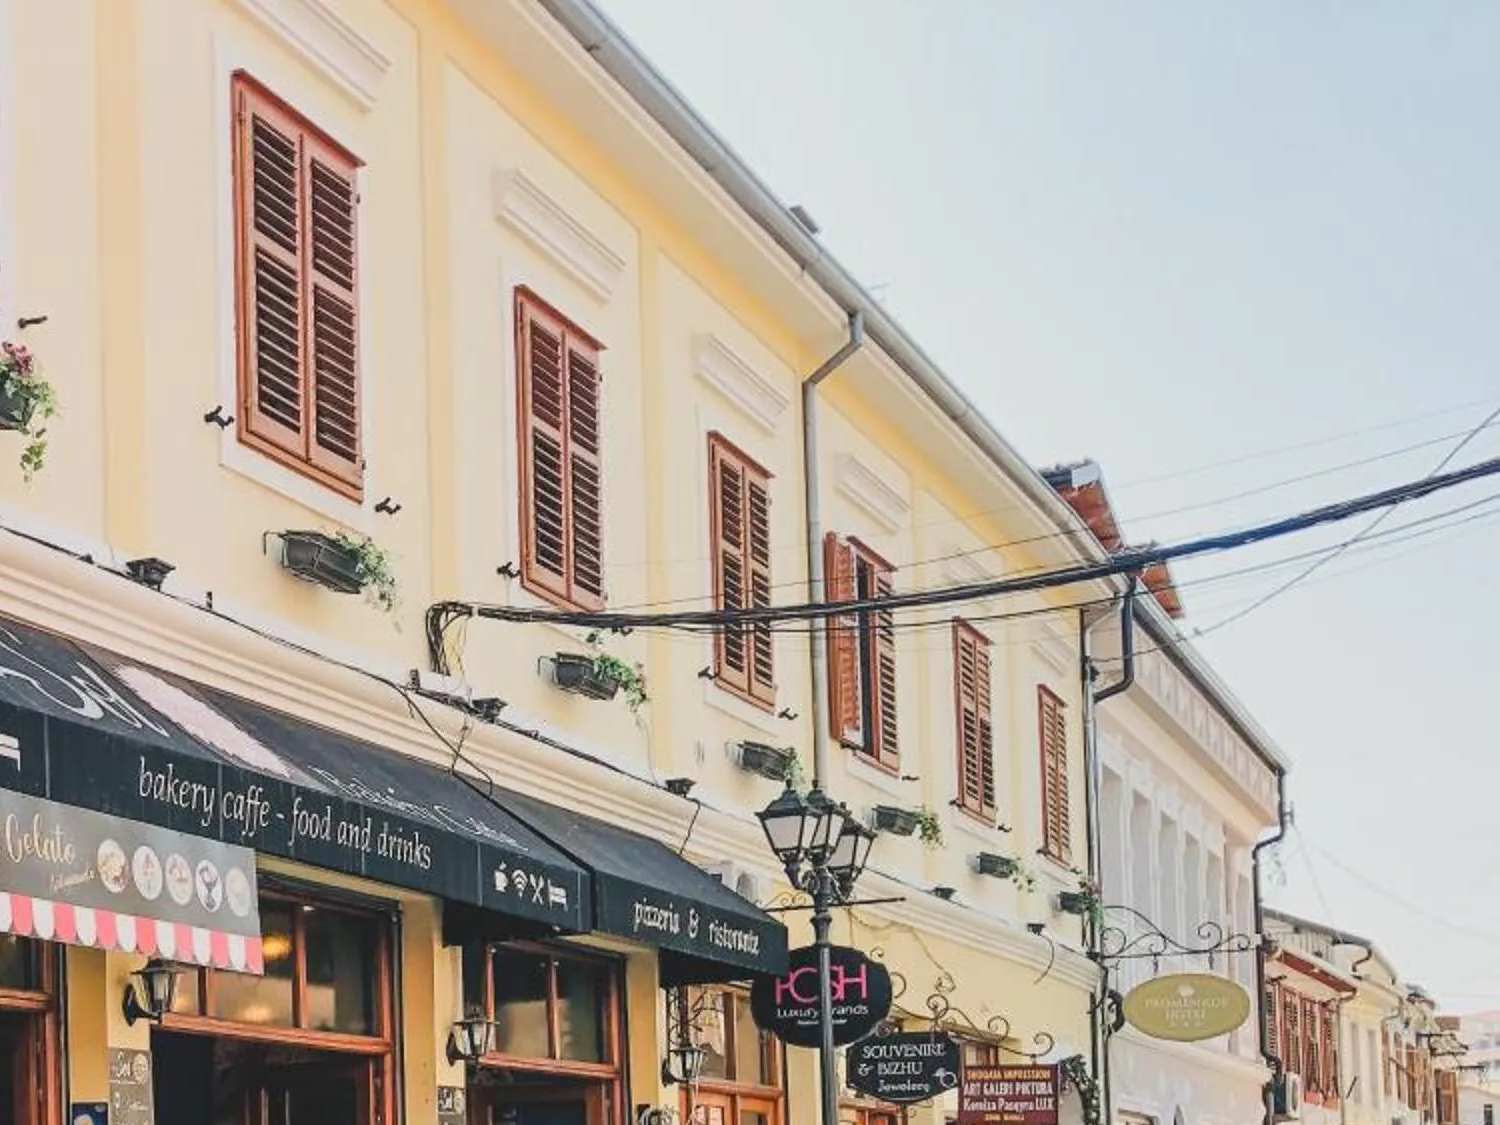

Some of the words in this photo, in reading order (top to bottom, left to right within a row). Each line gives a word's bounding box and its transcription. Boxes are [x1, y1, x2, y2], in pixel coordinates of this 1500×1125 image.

[138, 756, 215, 827] bakery
[222, 784, 269, 838] caffe
[287, 796, 331, 847] food
[337, 818, 371, 854] and
[376, 821, 431, 870] drinks
[634, 896, 680, 933] pizzeria
[708, 919, 760, 957] ristorante
[877, 1061, 923, 1076] BIZHU
